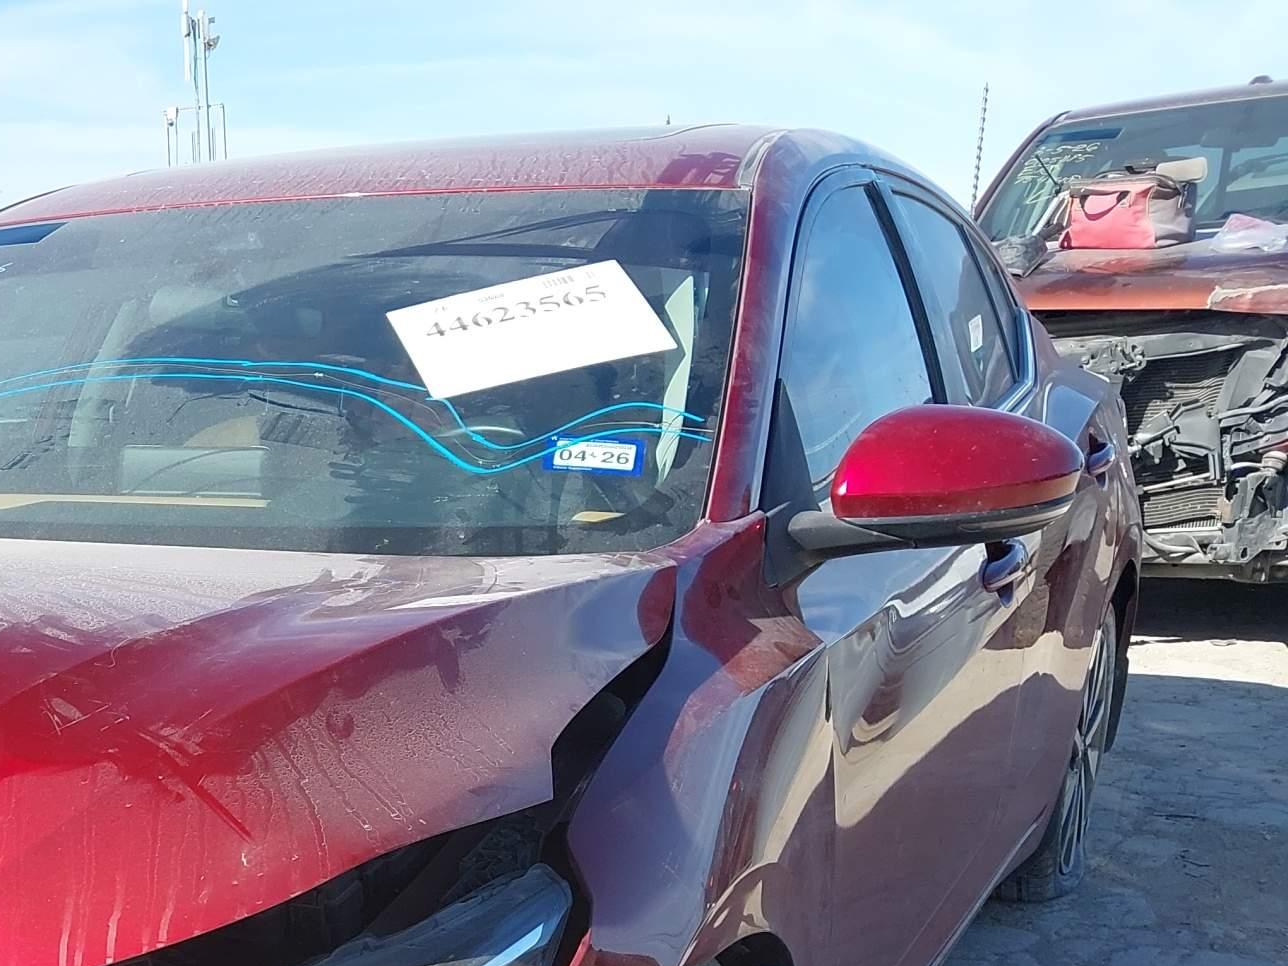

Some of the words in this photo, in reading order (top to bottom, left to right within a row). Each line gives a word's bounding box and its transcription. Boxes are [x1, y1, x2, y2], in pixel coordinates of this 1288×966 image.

[425, 284, 607, 338] 44623565
[559, 448, 587, 462] 04
[600, 451, 631, 465] 26
